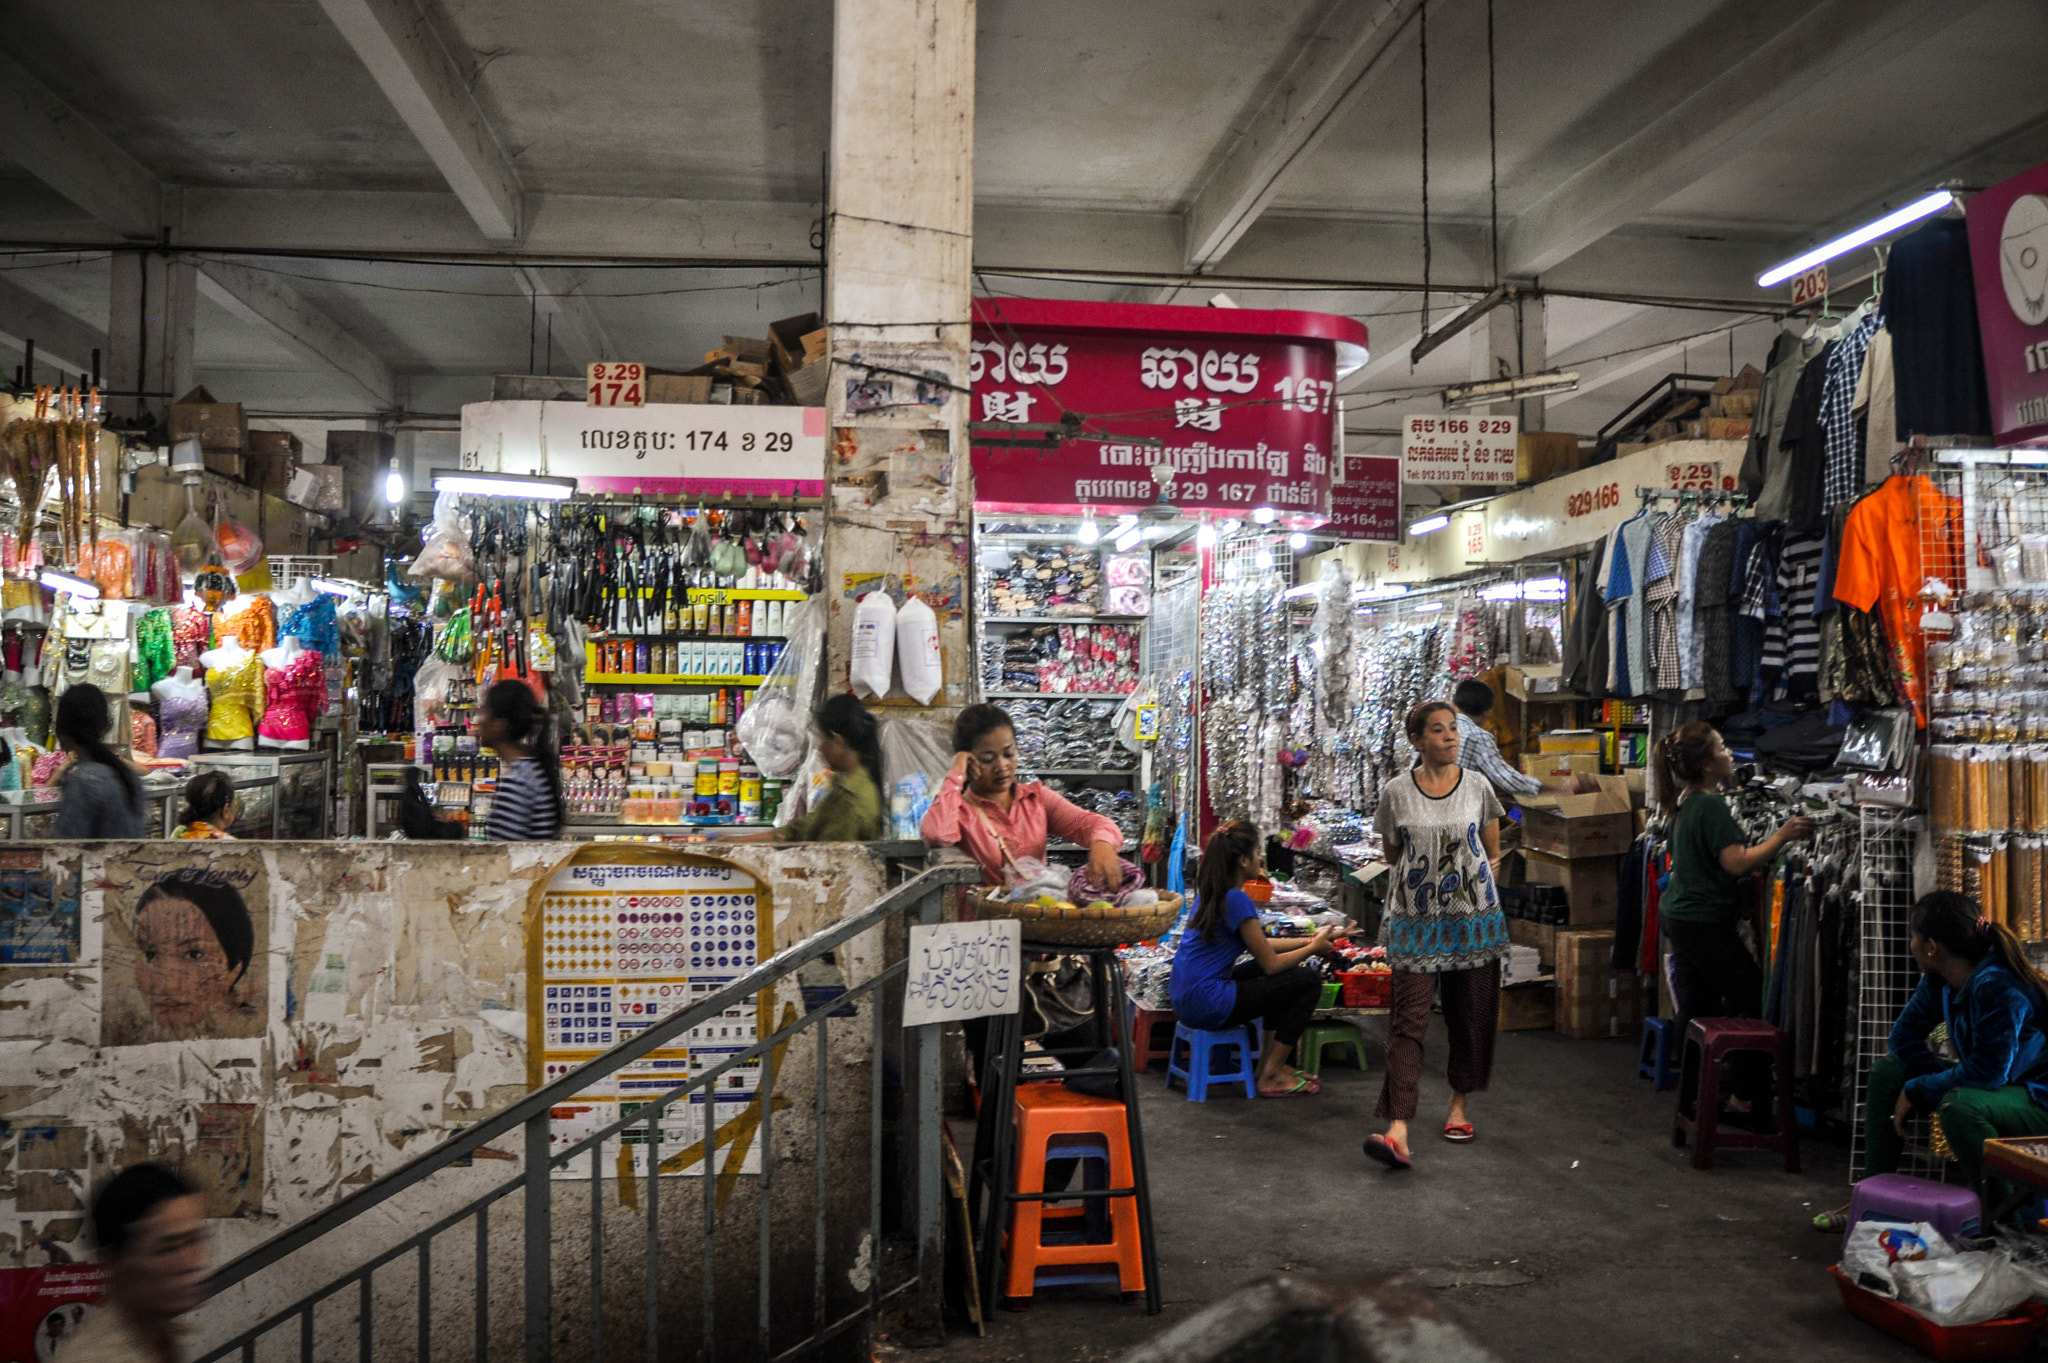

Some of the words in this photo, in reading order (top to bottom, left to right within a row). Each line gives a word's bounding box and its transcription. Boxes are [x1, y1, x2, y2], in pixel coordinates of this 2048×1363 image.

[1794, 268, 1827, 304] 203
[589, 383, 642, 406] 174
[1274, 376, 1334, 415] 167
[1438, 420, 1468, 433] 166
[686, 431, 728, 451] 174
[764, 432, 793, 452] 29
[462, 451, 478, 469] 161
[1422, 471, 1435, 480] 012
[1182, 482, 1208, 500] 29
[1218, 483, 1256, 502] 167
[688, 590, 728, 604] unsilk
